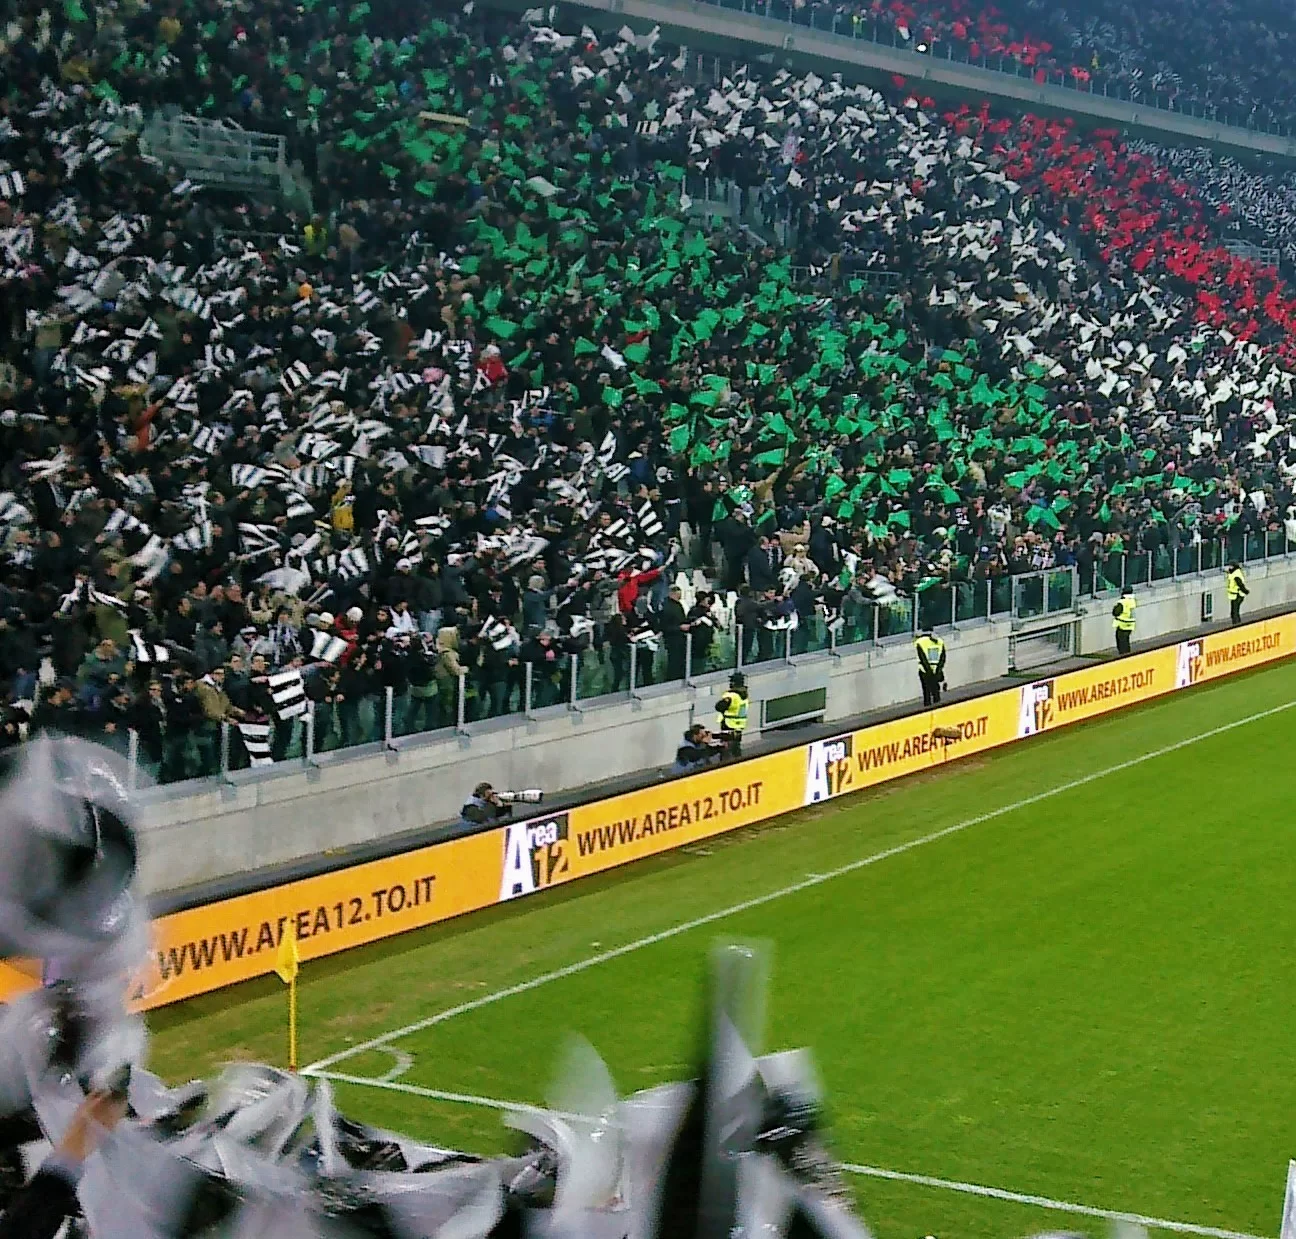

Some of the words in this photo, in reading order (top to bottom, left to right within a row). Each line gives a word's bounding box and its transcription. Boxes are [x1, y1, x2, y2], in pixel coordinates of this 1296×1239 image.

[1205, 631, 1281, 668] WWW.AREA12.TO.IT
[1058, 668, 1155, 712] WWW.AREA12.TO.IT
[1035, 699, 1054, 730] 12
[828, 757, 852, 793] 12
[577, 781, 763, 857] WWW.AREA12.TO.IT
[534, 838, 569, 887] 12
